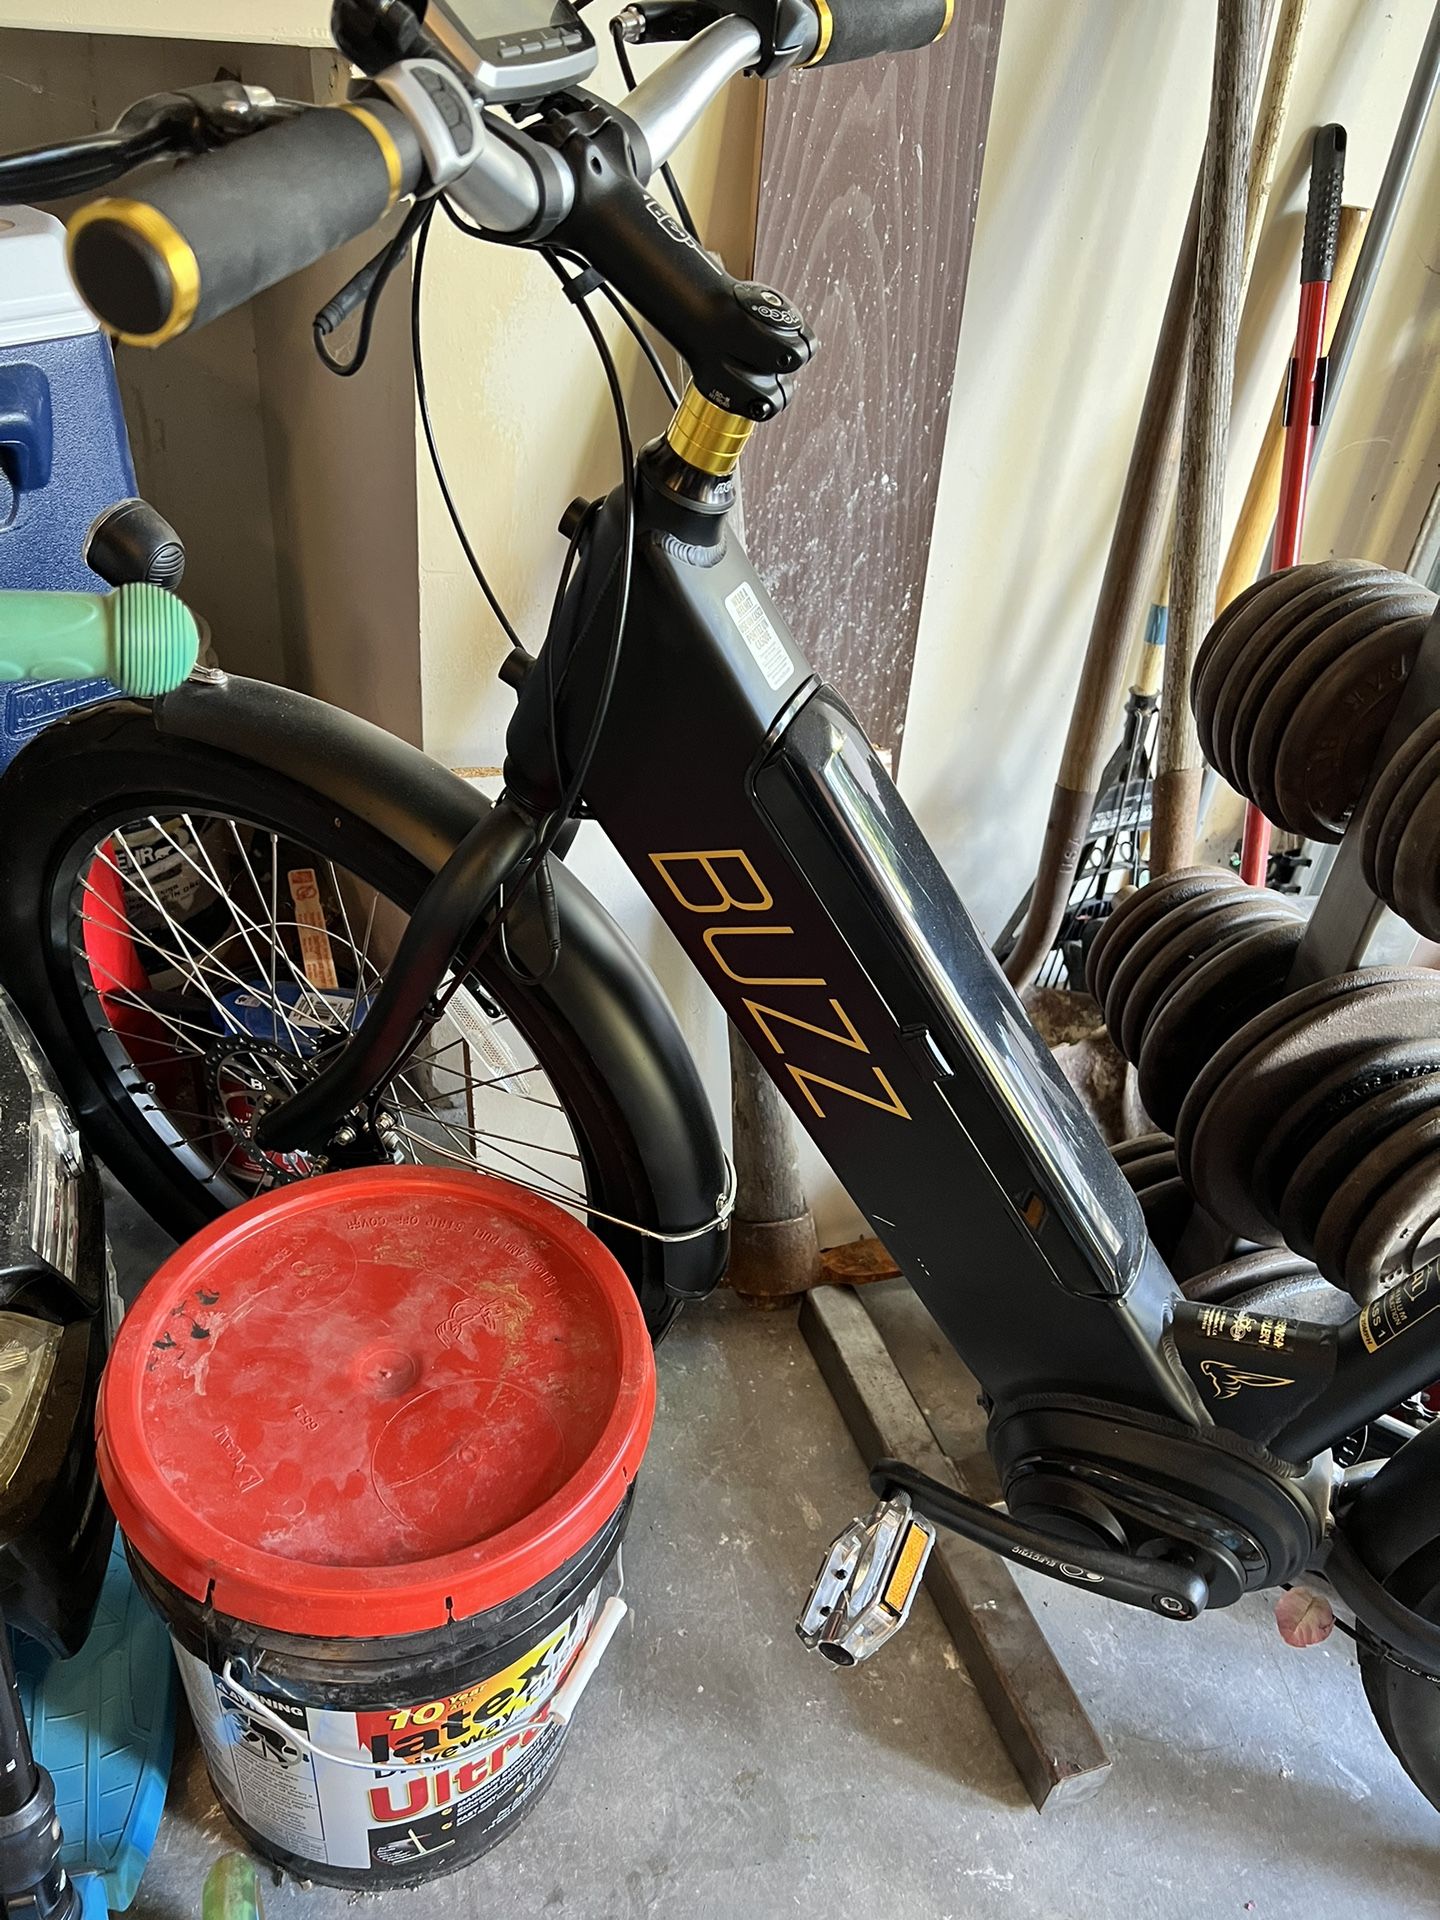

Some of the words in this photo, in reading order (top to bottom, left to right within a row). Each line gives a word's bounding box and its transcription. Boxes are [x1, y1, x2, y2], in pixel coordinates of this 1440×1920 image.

[648, 849, 912, 1121] BUZZ
[374, 1705, 517, 1779] Diveway
[388, 1702, 446, 1730] 10
[448, 1683, 488, 1705] Year
[369, 1699, 551, 1822] Ultra
